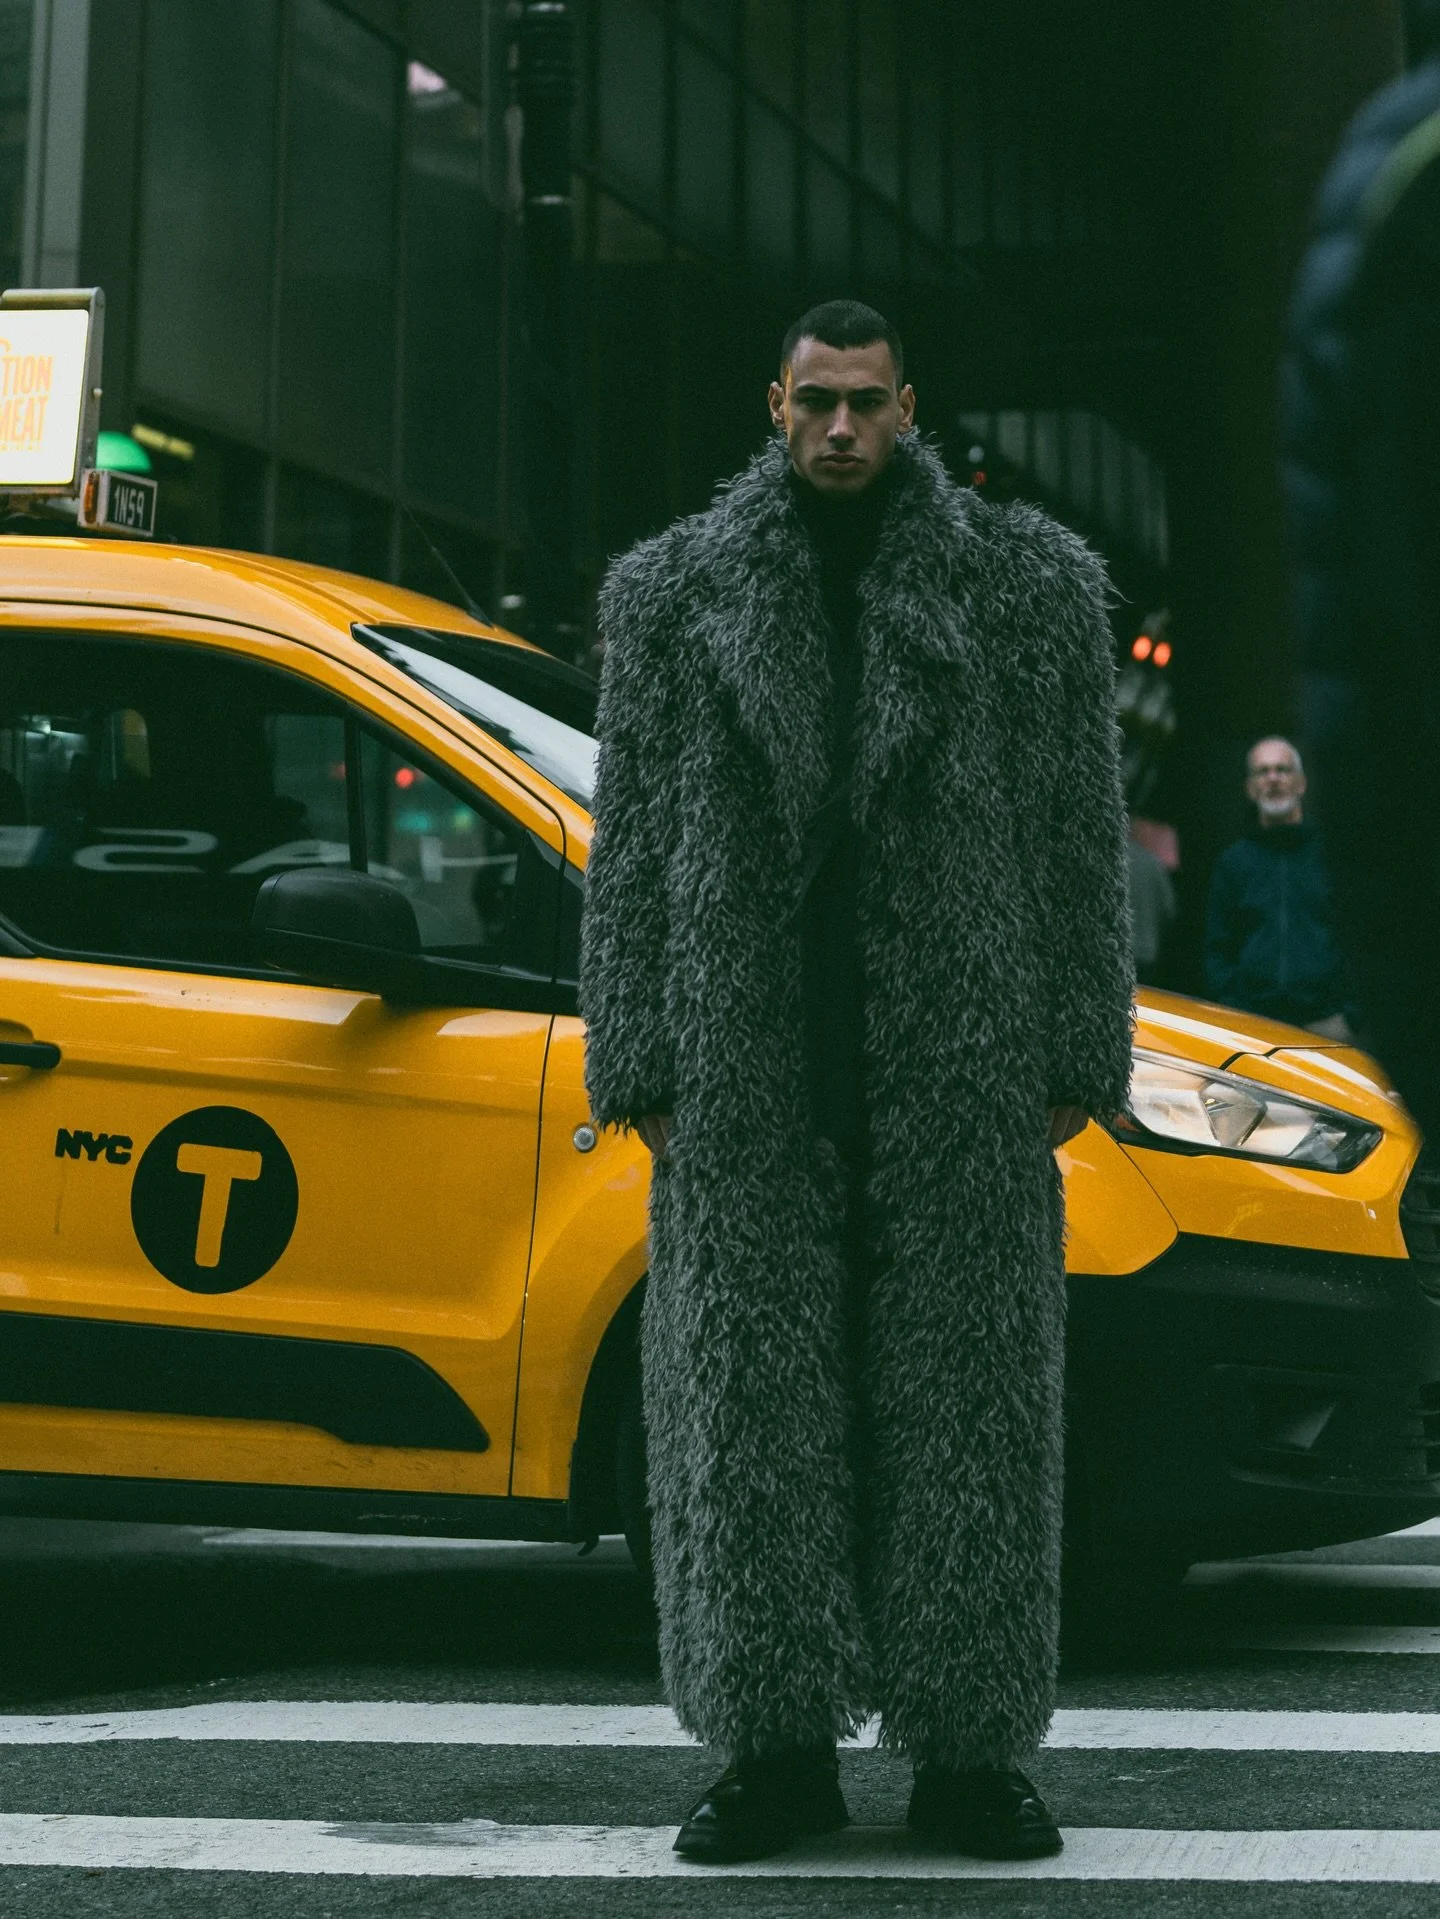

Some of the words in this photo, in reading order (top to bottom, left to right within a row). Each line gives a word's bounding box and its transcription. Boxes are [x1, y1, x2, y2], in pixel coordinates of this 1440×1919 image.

[114, 484, 145, 528] 1N59
[55, 1128, 133, 1165] NYC
[176, 1142, 263, 1268] T
